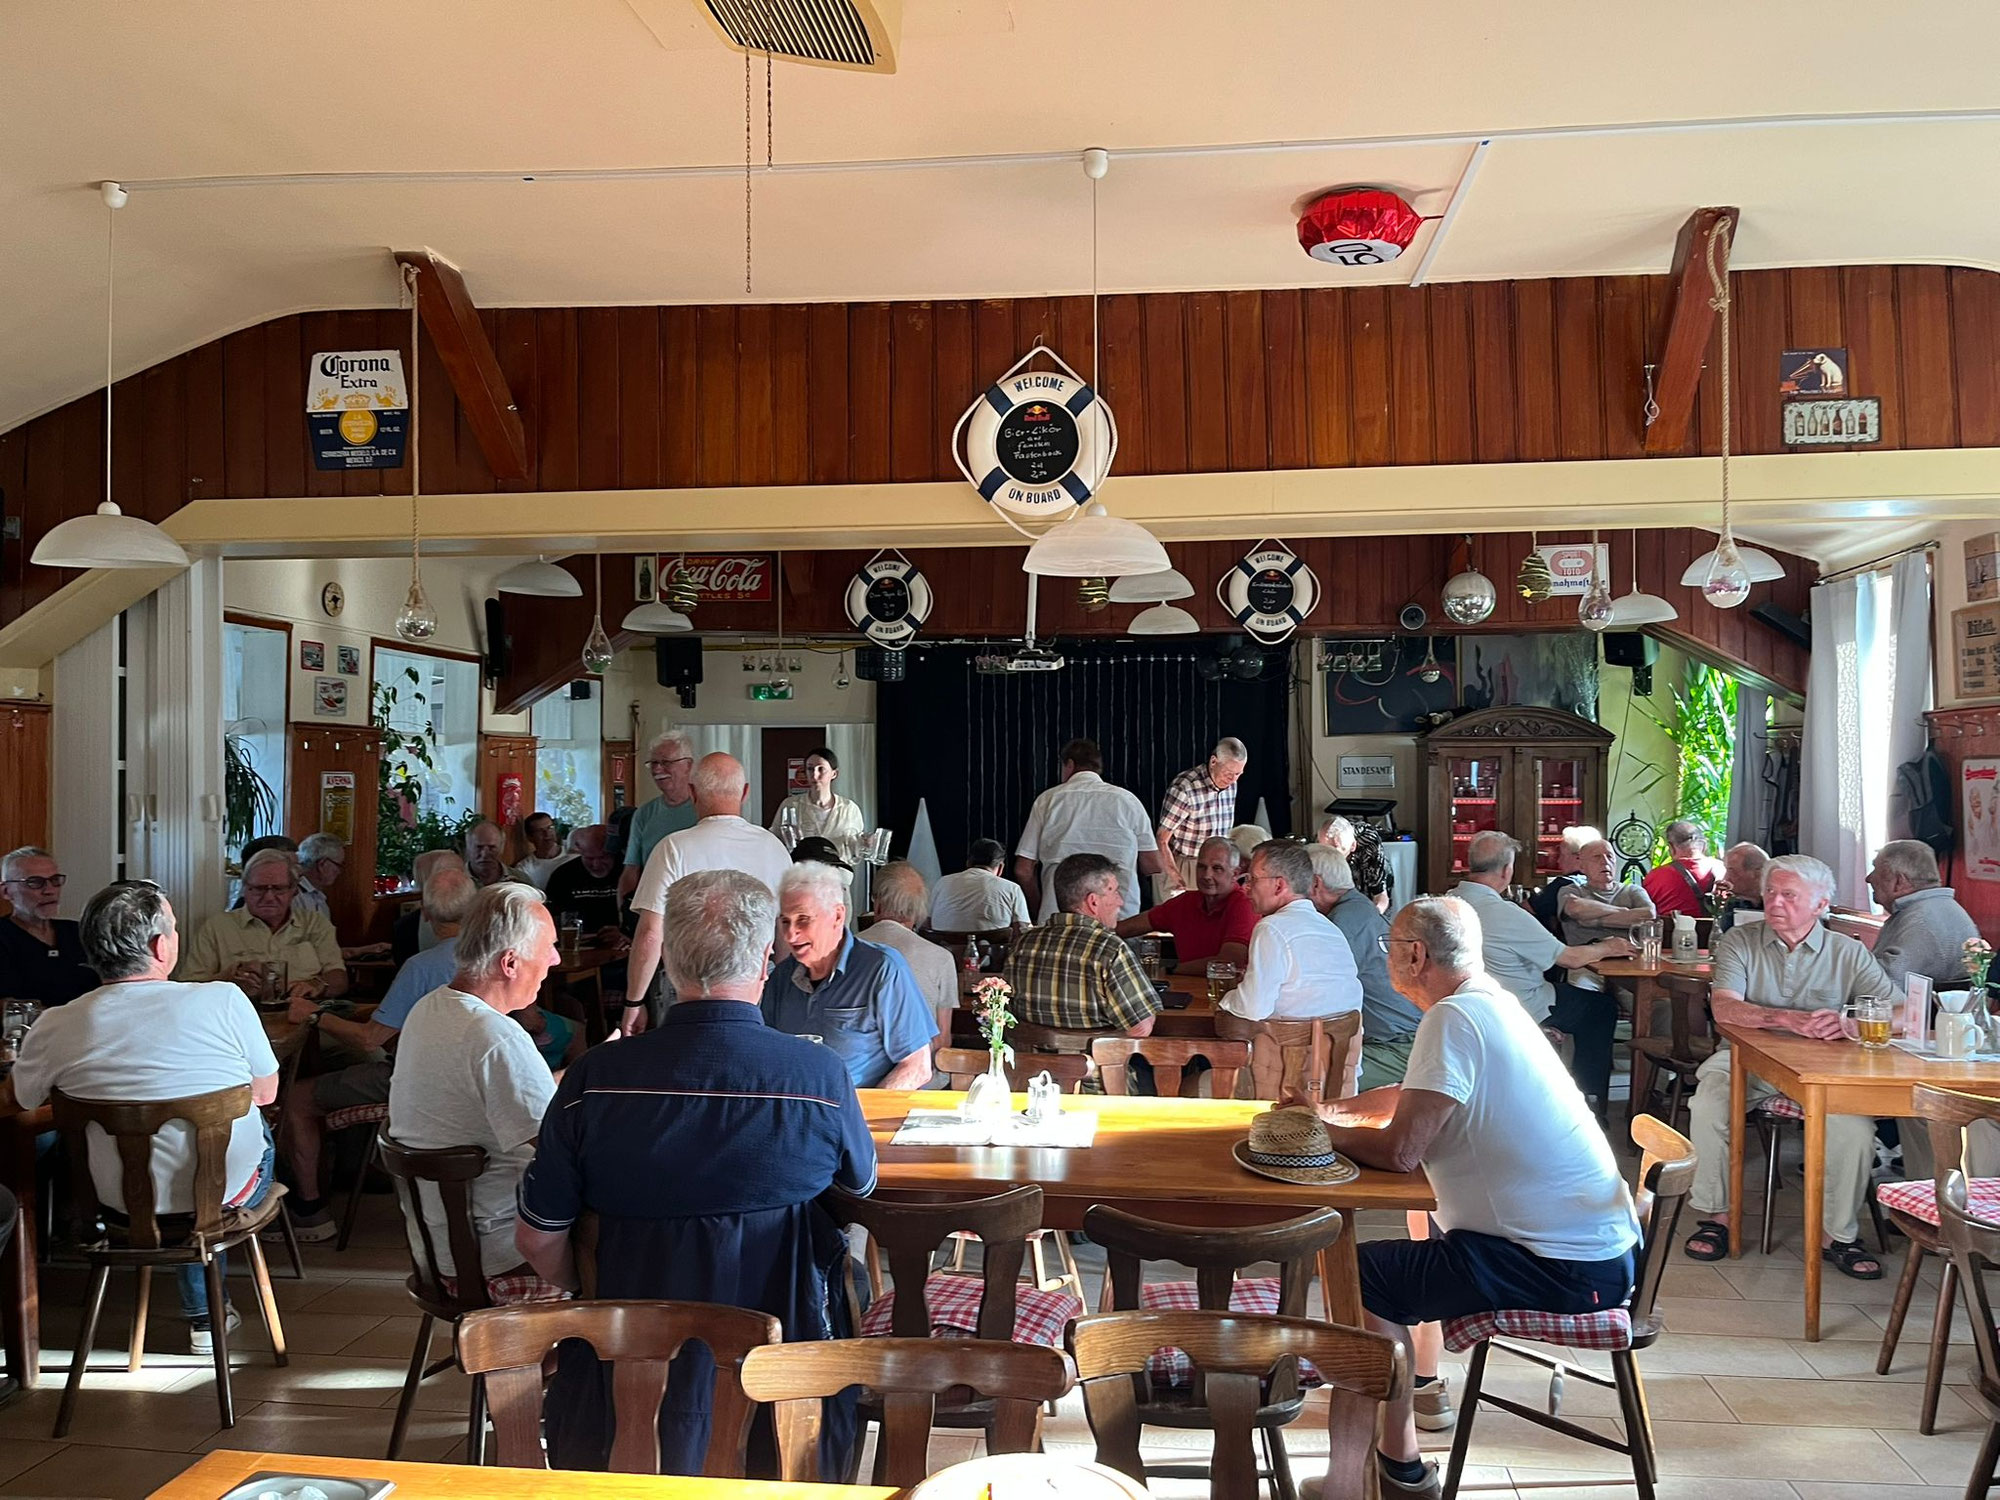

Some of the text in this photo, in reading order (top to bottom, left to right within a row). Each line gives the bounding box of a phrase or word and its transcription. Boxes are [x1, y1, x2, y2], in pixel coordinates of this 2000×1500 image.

[320, 355, 391, 379] Corona
[340, 374, 378, 389] Extra
[1013, 376, 1065, 392] WELCOME
[1008, 487, 1061, 503] ON BOARD
[1255, 554, 1284, 564] WELCOME
[873, 563, 901, 573] WELCOME
[1266, 616, 1287, 626] BOARD
[885, 624, 904, 634] BOARD
[1342, 766, 1391, 775] STANDESAMT
